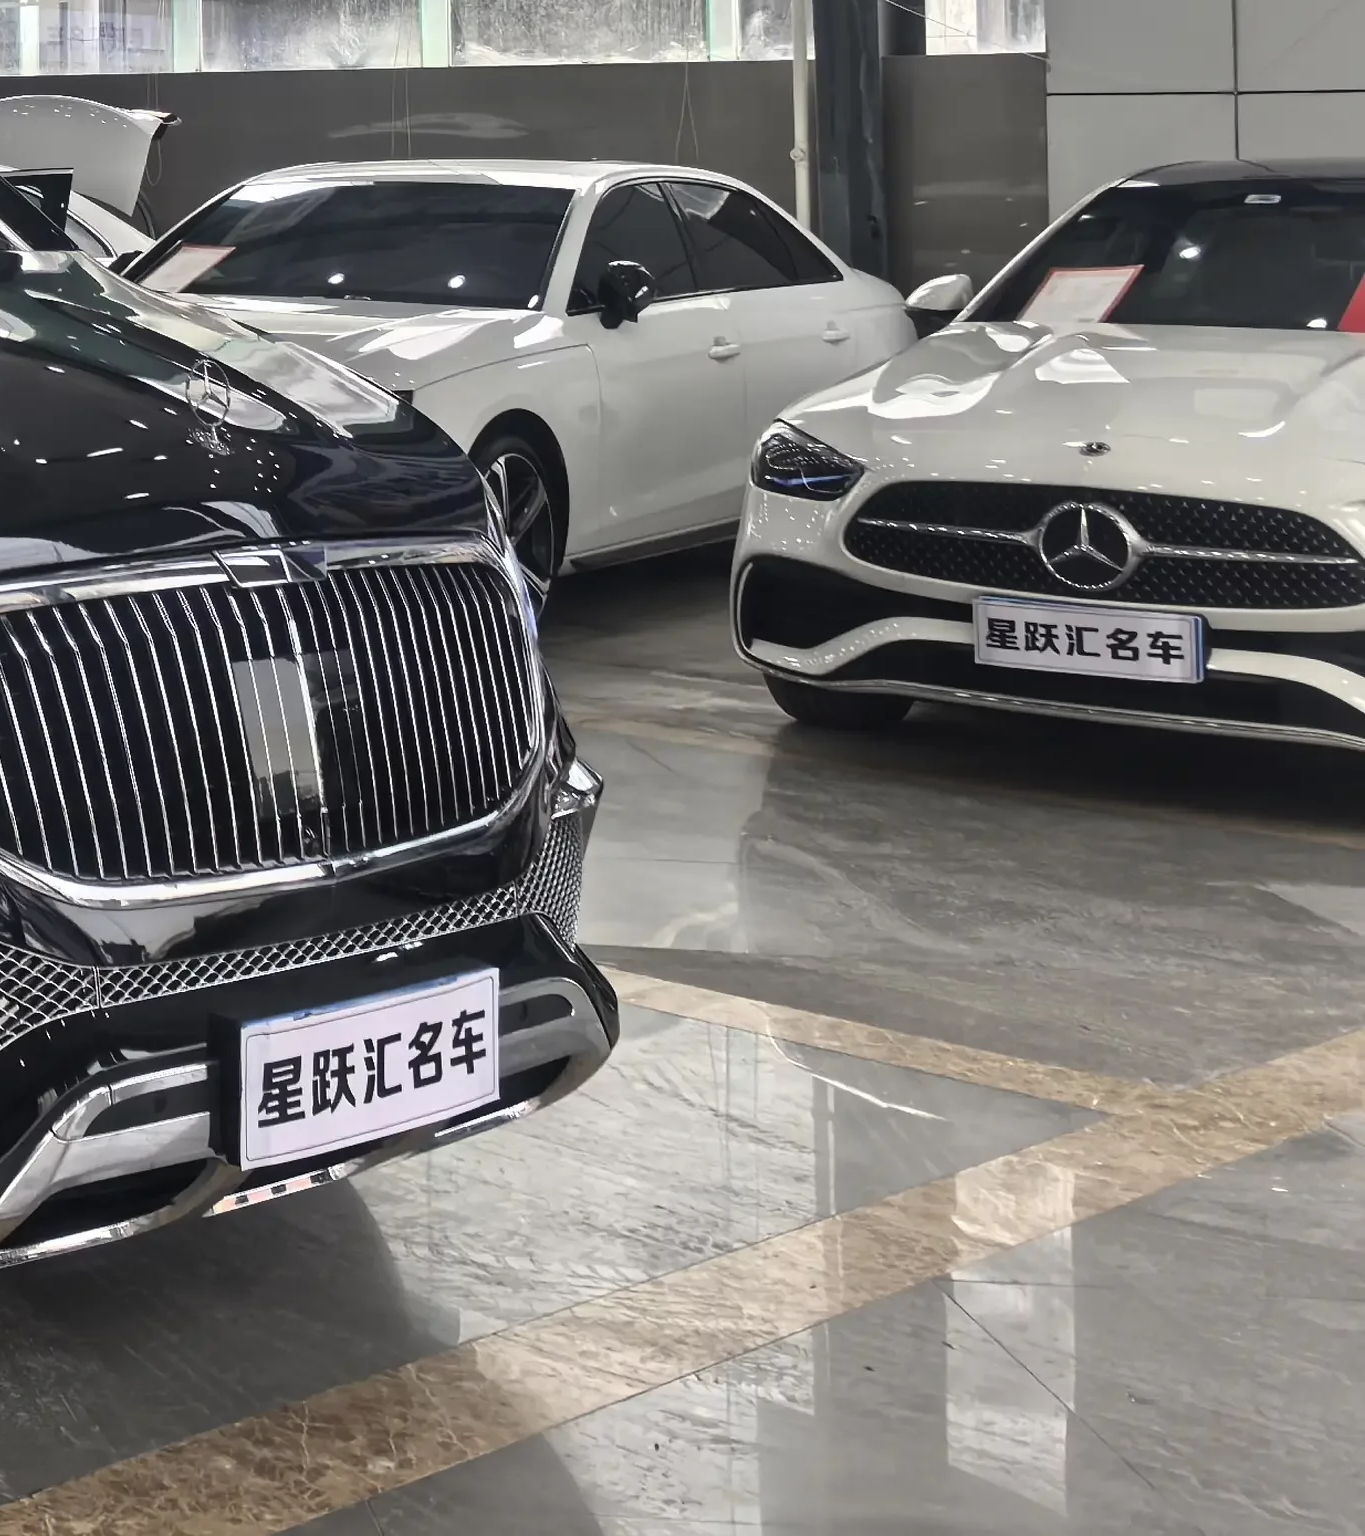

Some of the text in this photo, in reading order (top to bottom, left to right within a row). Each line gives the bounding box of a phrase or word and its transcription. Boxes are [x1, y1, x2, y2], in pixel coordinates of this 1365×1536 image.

[984, 617, 1186, 666] 星跃汇名车
[256, 1008, 488, 1129] 星跃汇名车
